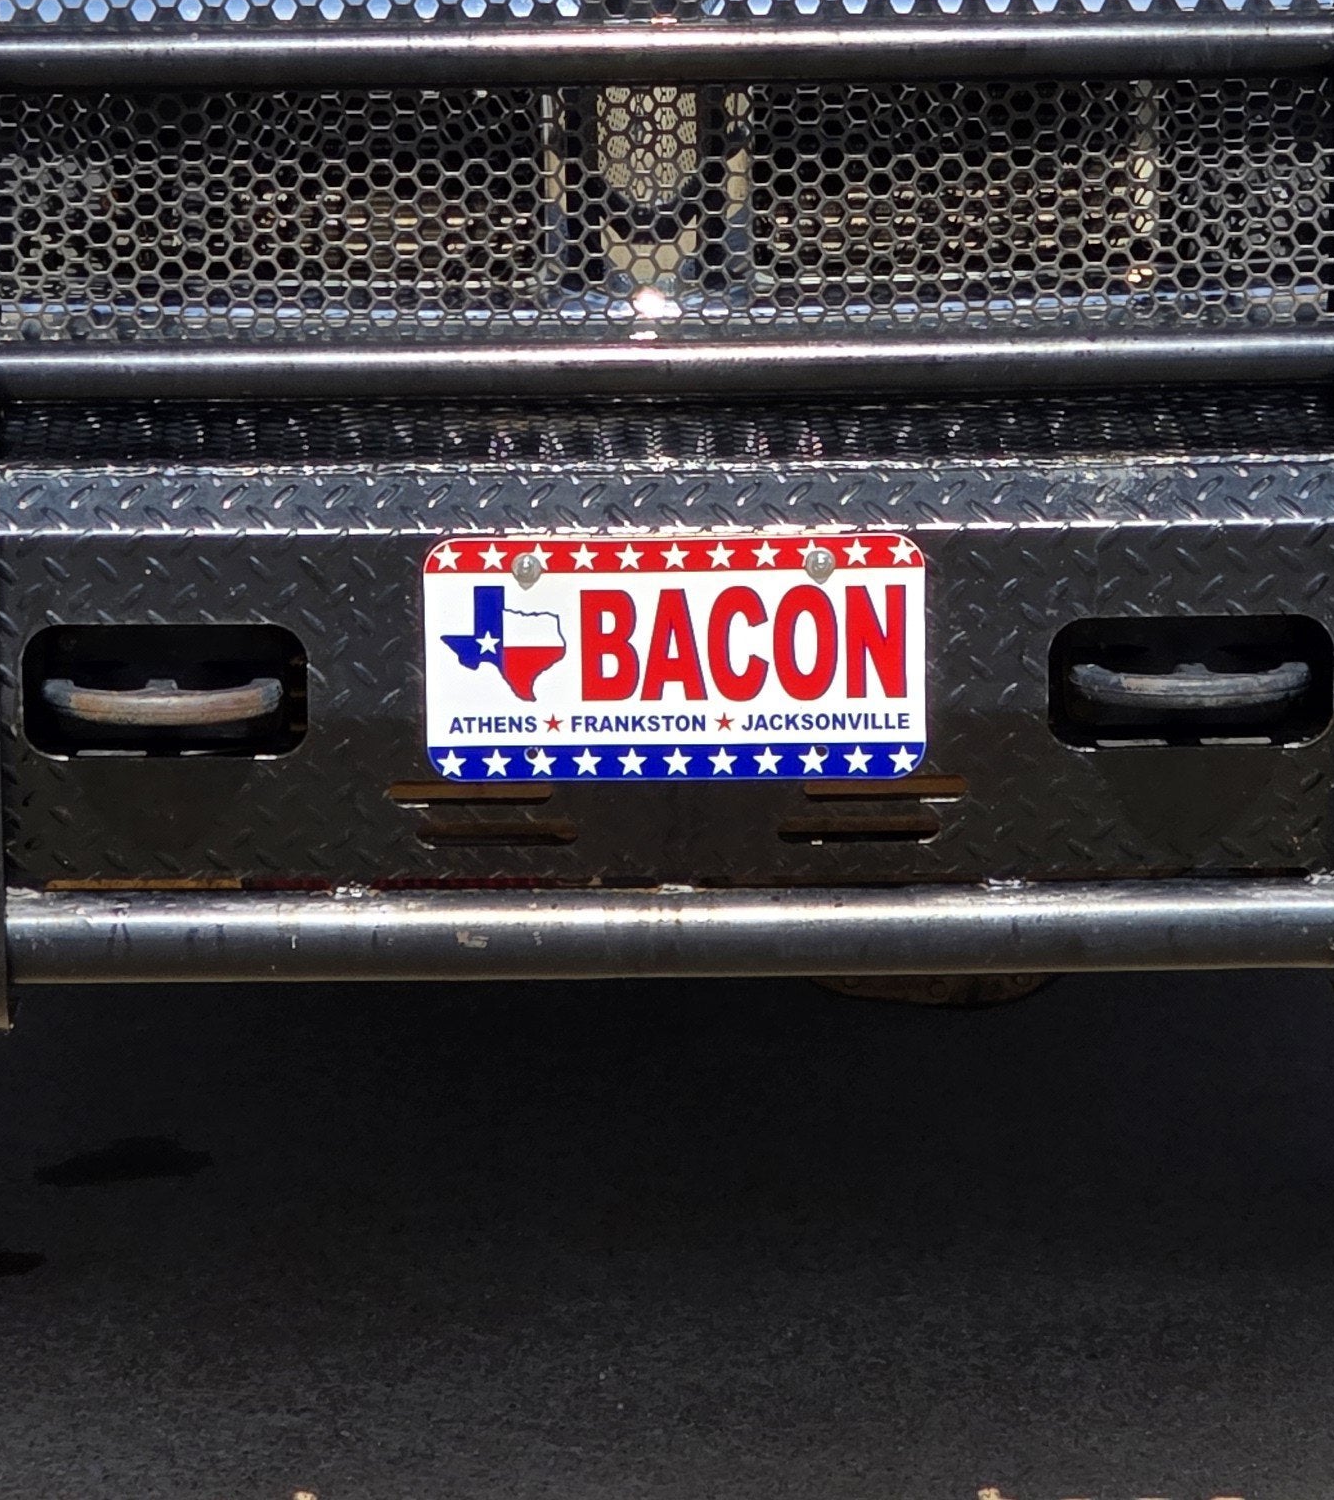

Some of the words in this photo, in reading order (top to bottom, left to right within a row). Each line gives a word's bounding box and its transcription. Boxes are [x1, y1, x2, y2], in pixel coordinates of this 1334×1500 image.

[580, 584, 907, 702] BACON
[448, 714, 538, 734] ATHENS
[570, 714, 707, 733] FRANKSTON
[741, 712, 910, 732] JACKSONVILLE
